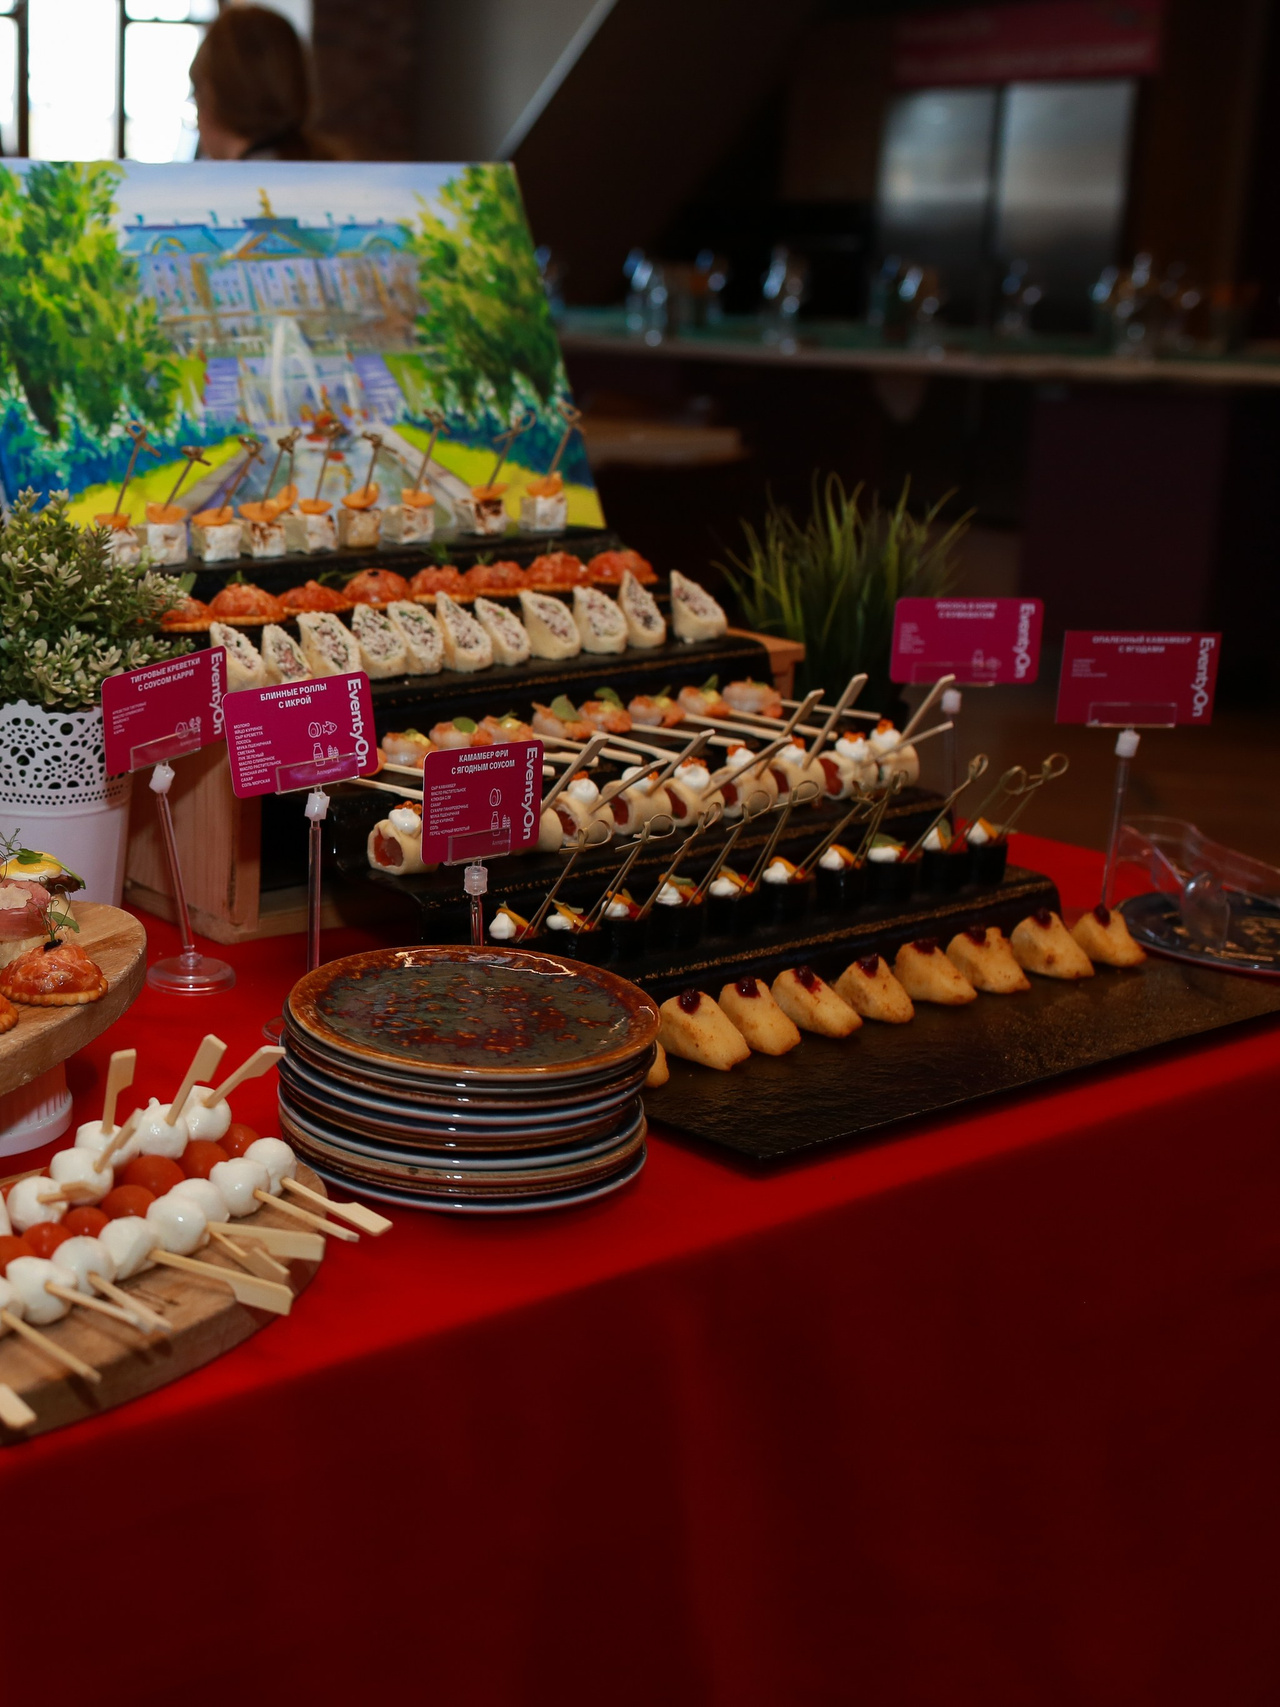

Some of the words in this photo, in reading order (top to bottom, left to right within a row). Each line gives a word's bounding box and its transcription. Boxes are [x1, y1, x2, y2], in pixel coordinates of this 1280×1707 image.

[1012, 603, 1035, 679] EventyOn
[131, 667, 166, 684] ТИГРОВЫЕ
[167, 657, 201, 675] КРЕВЕТКИ
[143, 676, 172, 690] СОУСОМ
[172, 669, 195, 682] КАРРИ
[1191, 637, 1215, 717] EventyOn
[209, 652, 225, 735] EventyOn
[260, 688, 298, 702] БЛИННЫЕ
[299, 683, 327, 695] РОЛЛЫ
[278, 701, 284, 709] С
[285, 695, 312, 708] ИКРОЙ
[347, 678, 369, 767] EventyOn
[451, 767, 456, 775] С
[456, 762, 489, 774] ЯГОДНЫМ
[489, 760, 515, 770] СОУСОМ
[459, 751, 494, 763] КАМАМБЕР
[495, 749, 508, 758] ФРИ
[521, 747, 538, 840] EventyOn
